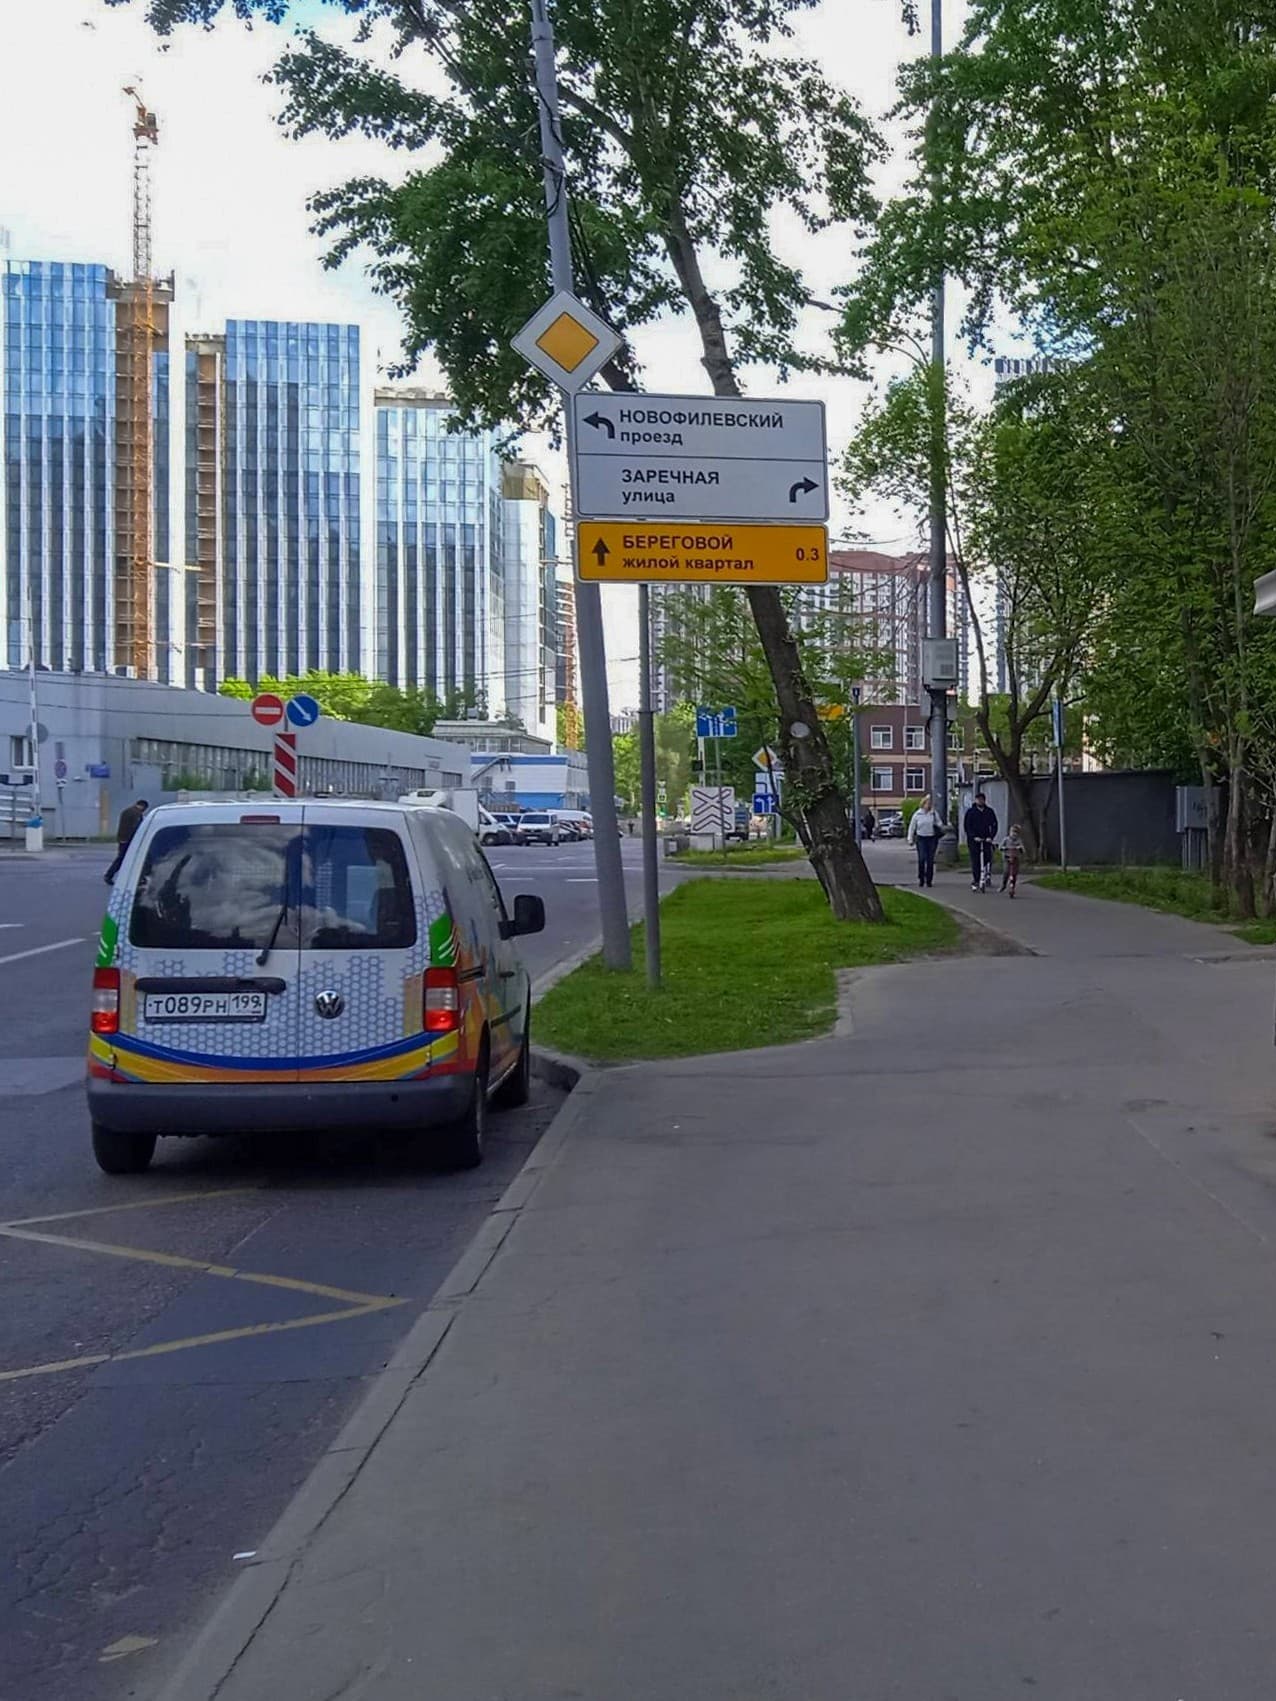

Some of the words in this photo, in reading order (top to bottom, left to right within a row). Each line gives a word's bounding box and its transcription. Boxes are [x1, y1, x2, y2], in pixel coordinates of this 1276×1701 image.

[620, 409, 784, 428] НОВОФИЛЕВСКИЙ
[620, 431, 683, 445] проезд
[621, 469, 720, 485] ЗАРЕЧНАЯ
[622, 490, 675, 504] улица
[623, 534, 733, 550] БЕРЕГОВОЙ
[796, 548, 820, 561] 0.3
[623, 555, 680, 569] жилой
[685, 559, 754, 572] квартал
